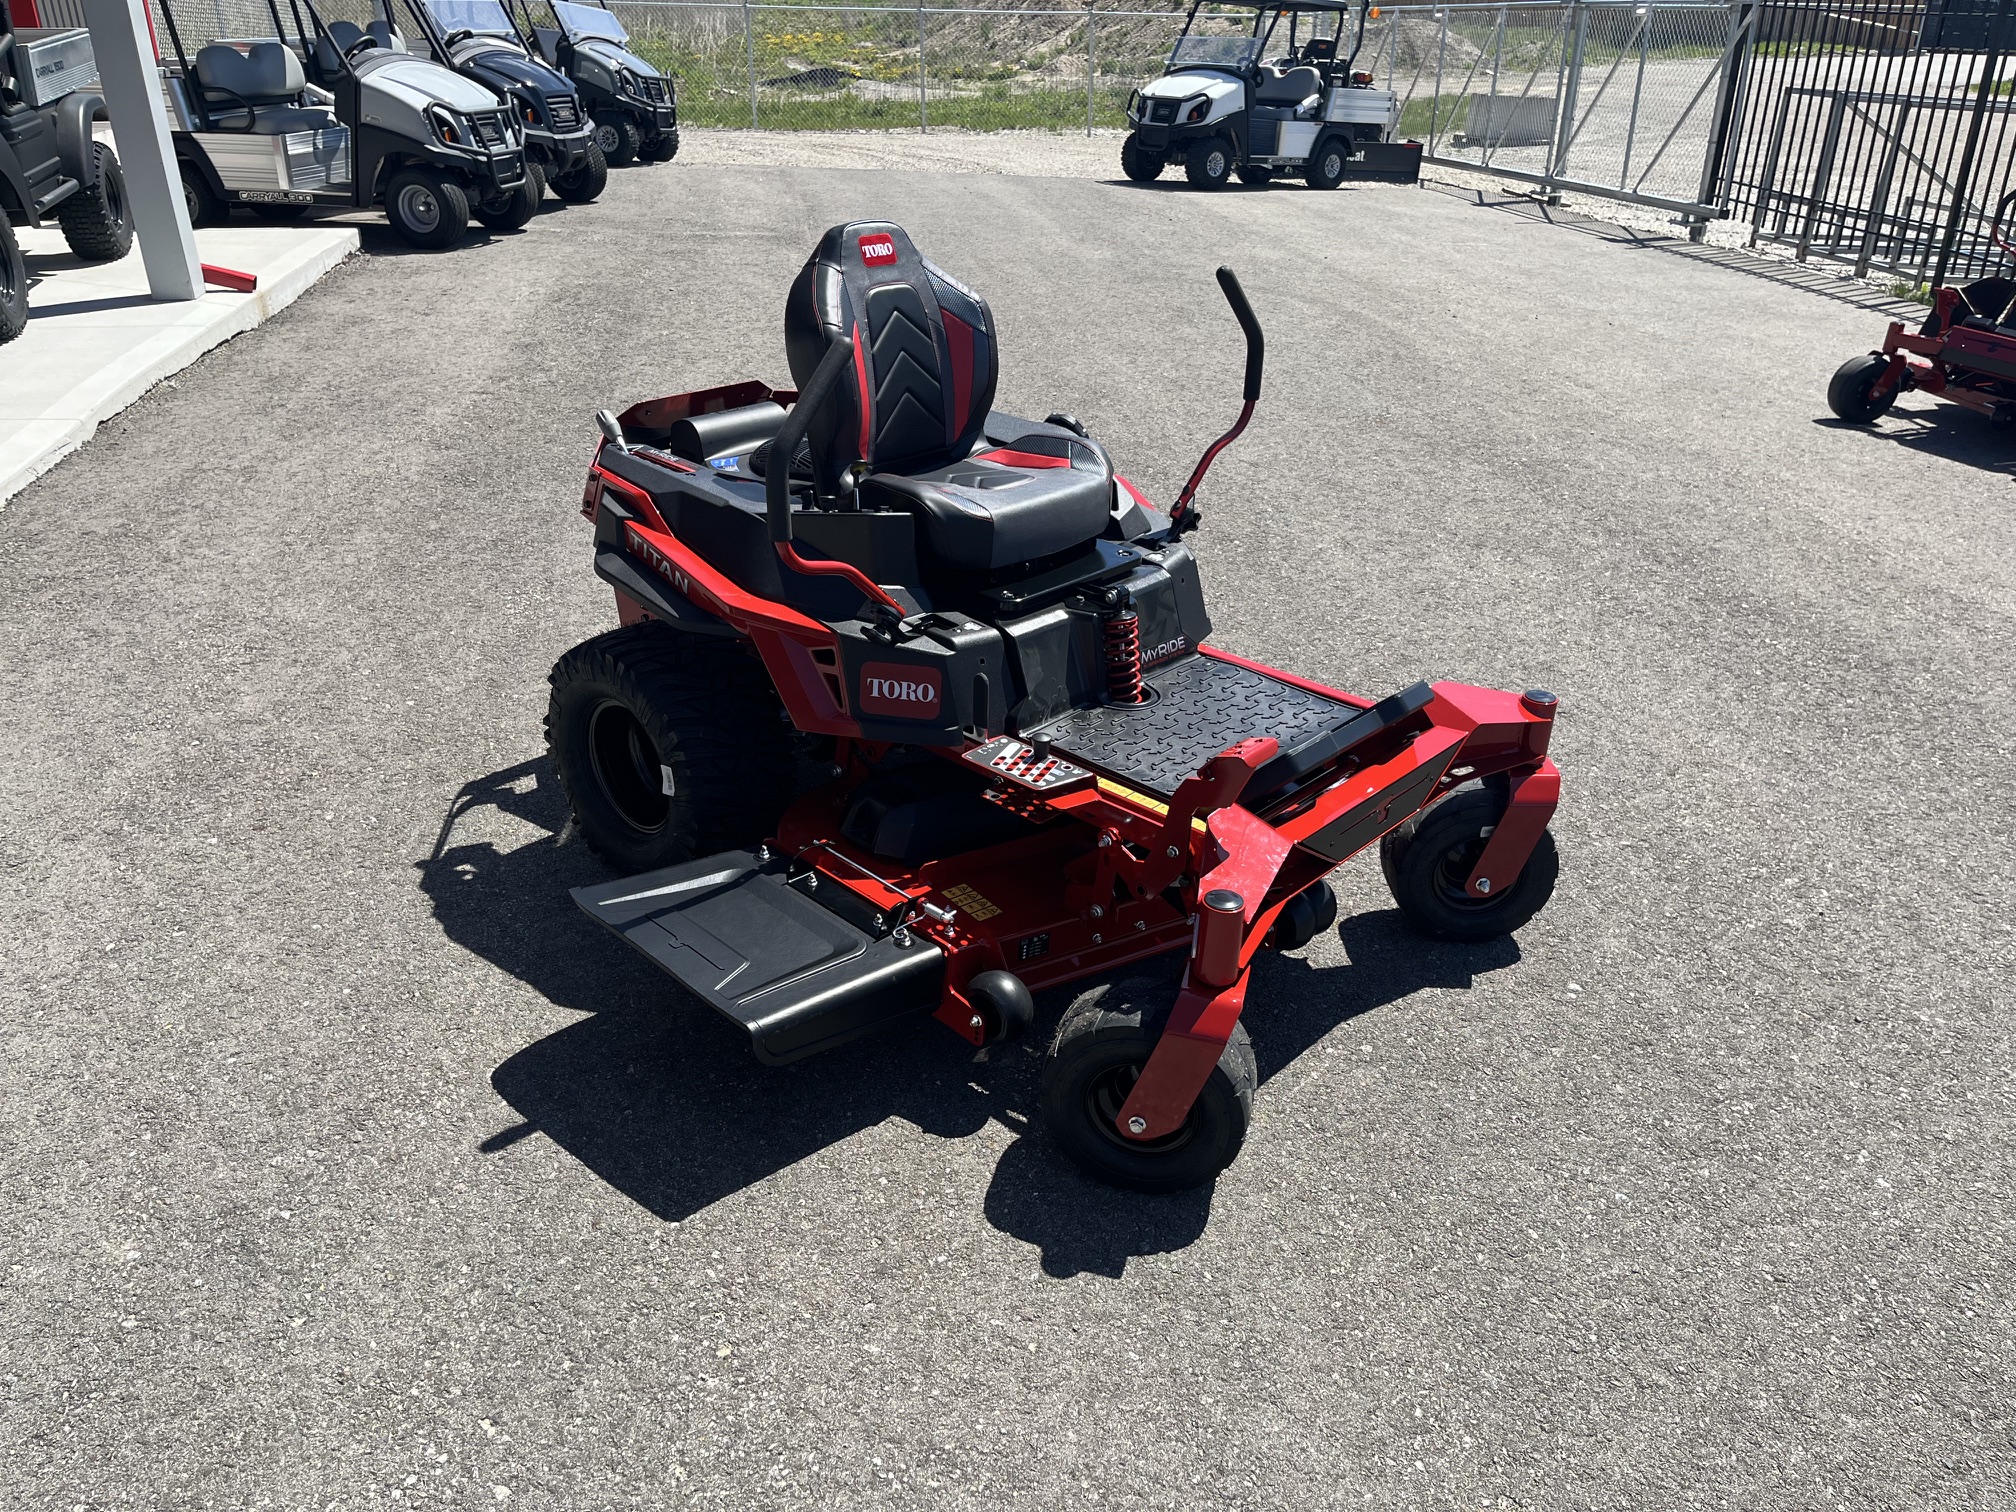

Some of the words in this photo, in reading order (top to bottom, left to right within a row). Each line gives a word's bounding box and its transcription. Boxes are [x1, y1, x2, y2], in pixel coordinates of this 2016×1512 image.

[239, 191, 288, 202] CARRYALL
[288, 193, 313, 203] 300
[862, 243, 893, 258] TORO
[630, 532, 688, 594] TITAN
[1141, 636, 1186, 664] MYRIDE
[867, 677, 935, 703] TORO
